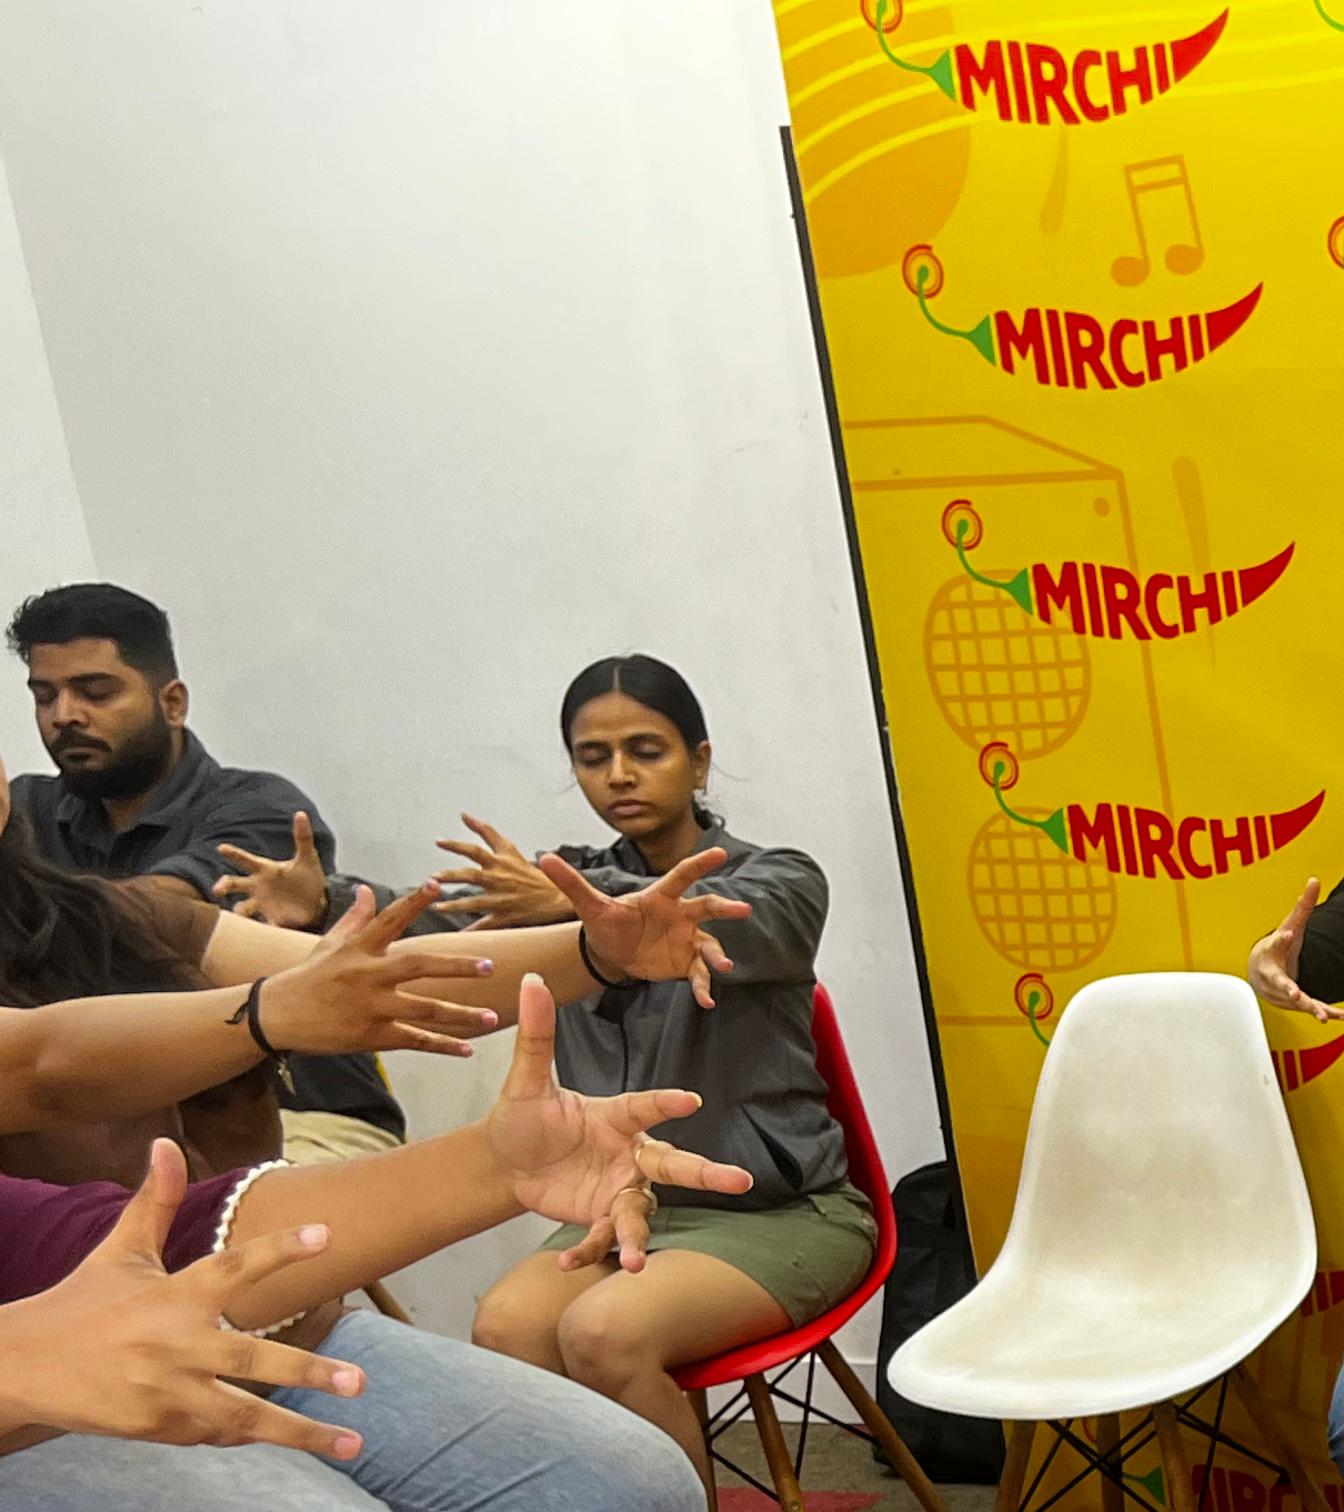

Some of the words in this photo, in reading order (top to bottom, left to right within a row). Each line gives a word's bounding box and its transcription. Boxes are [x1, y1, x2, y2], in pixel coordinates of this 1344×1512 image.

[954, 40, 1170, 125] MIRCHI
[993, 307, 1206, 390] MIRCHI
[1031, 560, 1239, 641] MIRCHI
[1066, 801, 1271, 881] MIRCHI
